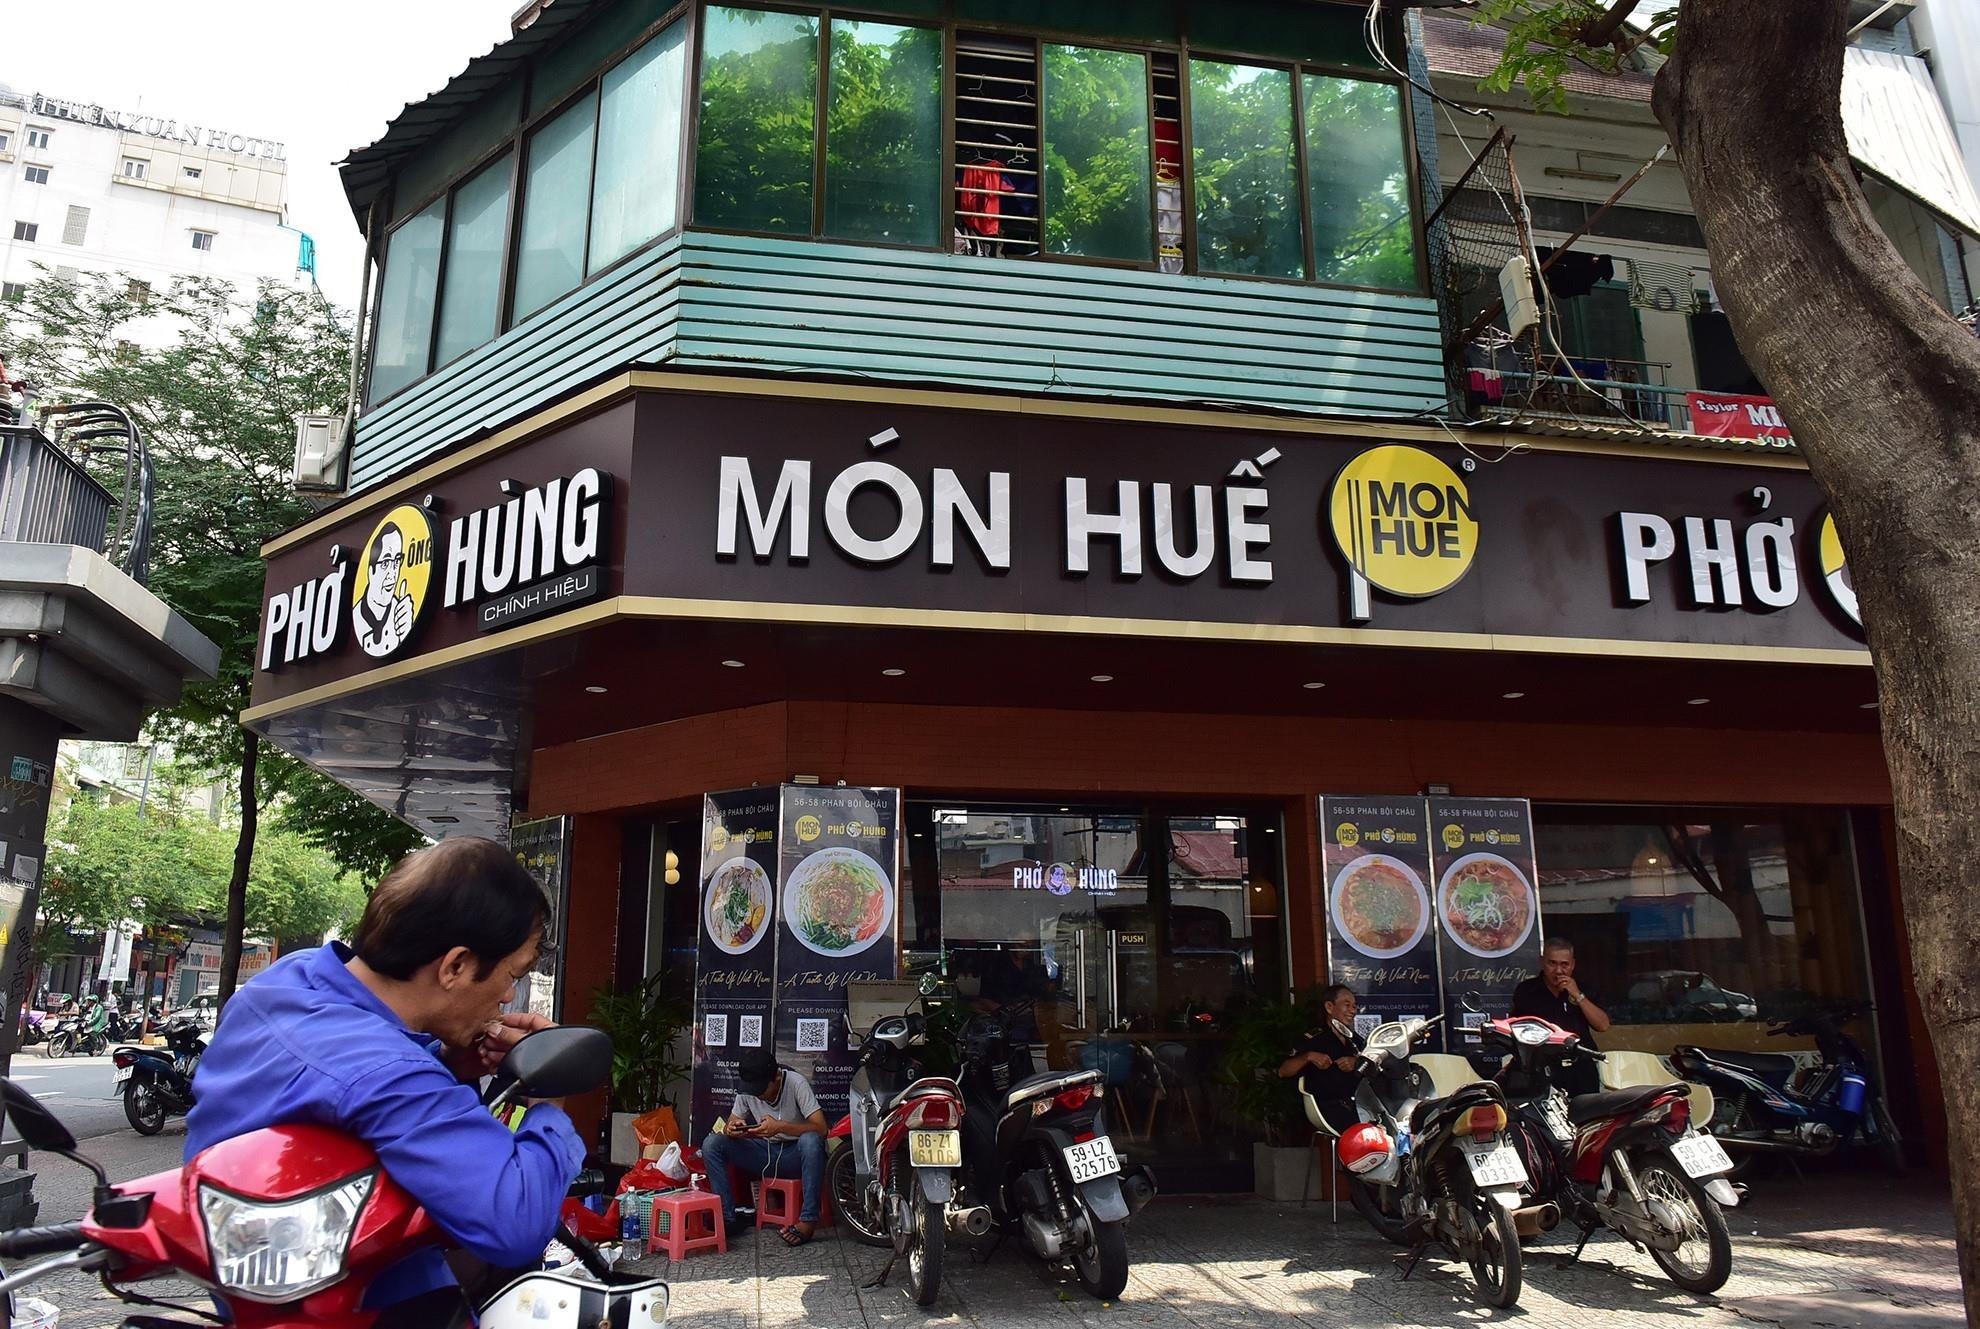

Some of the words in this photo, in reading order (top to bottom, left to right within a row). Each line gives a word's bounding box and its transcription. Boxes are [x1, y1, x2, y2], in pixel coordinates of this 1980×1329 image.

[126, 113, 201, 145] XUÂN
[207, 129, 286, 161] HOTEL
[1696, 400, 1738, 413] Taylor
[1745, 404, 1786, 428] MI
[716, 427, 1010, 570] MÓN
[1065, 447, 1282, 582] HUẾ
[1369, 481, 1477, 521] MON
[444, 468, 600, 608] HÙNG
[1373, 519, 1460, 559] HUE
[1620, 487, 1799, 607] PHỞ
[406, 539, 431, 568] ÔNG
[261, 545, 347, 671] PHỞ
[484, 594, 540, 622] CHÍNH
[545, 574, 589, 604] HIỆU
[728, 808, 744, 816] PHAN
[795, 798, 818, 807] 56-58
[822, 799, 844, 807] PHAN
[848, 797, 861, 808] BỘI
[865, 798, 887, 808] CHÂU
[1333, 806, 1355, 815] 56-58
[1357, 807, 1378, 815] PHAN
[1380, 805, 1392, 816] BỘI
[1395, 806, 1416, 816] CHÂU
[1439, 809, 1460, 817] 56-58
[1462, 809, 1481, 817] PHAN
[827, 822, 845, 835] PHỞ
[1013, 860, 1042, 889] PHỞ
[1079, 864, 1117, 889] HÙNG
[1121, 934, 1144, 943] PUSH
[725, 970, 736, 990] Of
[784, 973, 798, 988] A
[824, 971, 839, 991] Of
[1374, 967, 1388, 986] Of
[1482, 967, 1495, 986] Of
[917, 1133, 951, 1148] 86-Z1
[1072, 1141, 1107, 1163] 59-L2
[1474, 1151, 1512, 1168] 60-P6
[1073, 1155, 1116, 1180] 325.76
